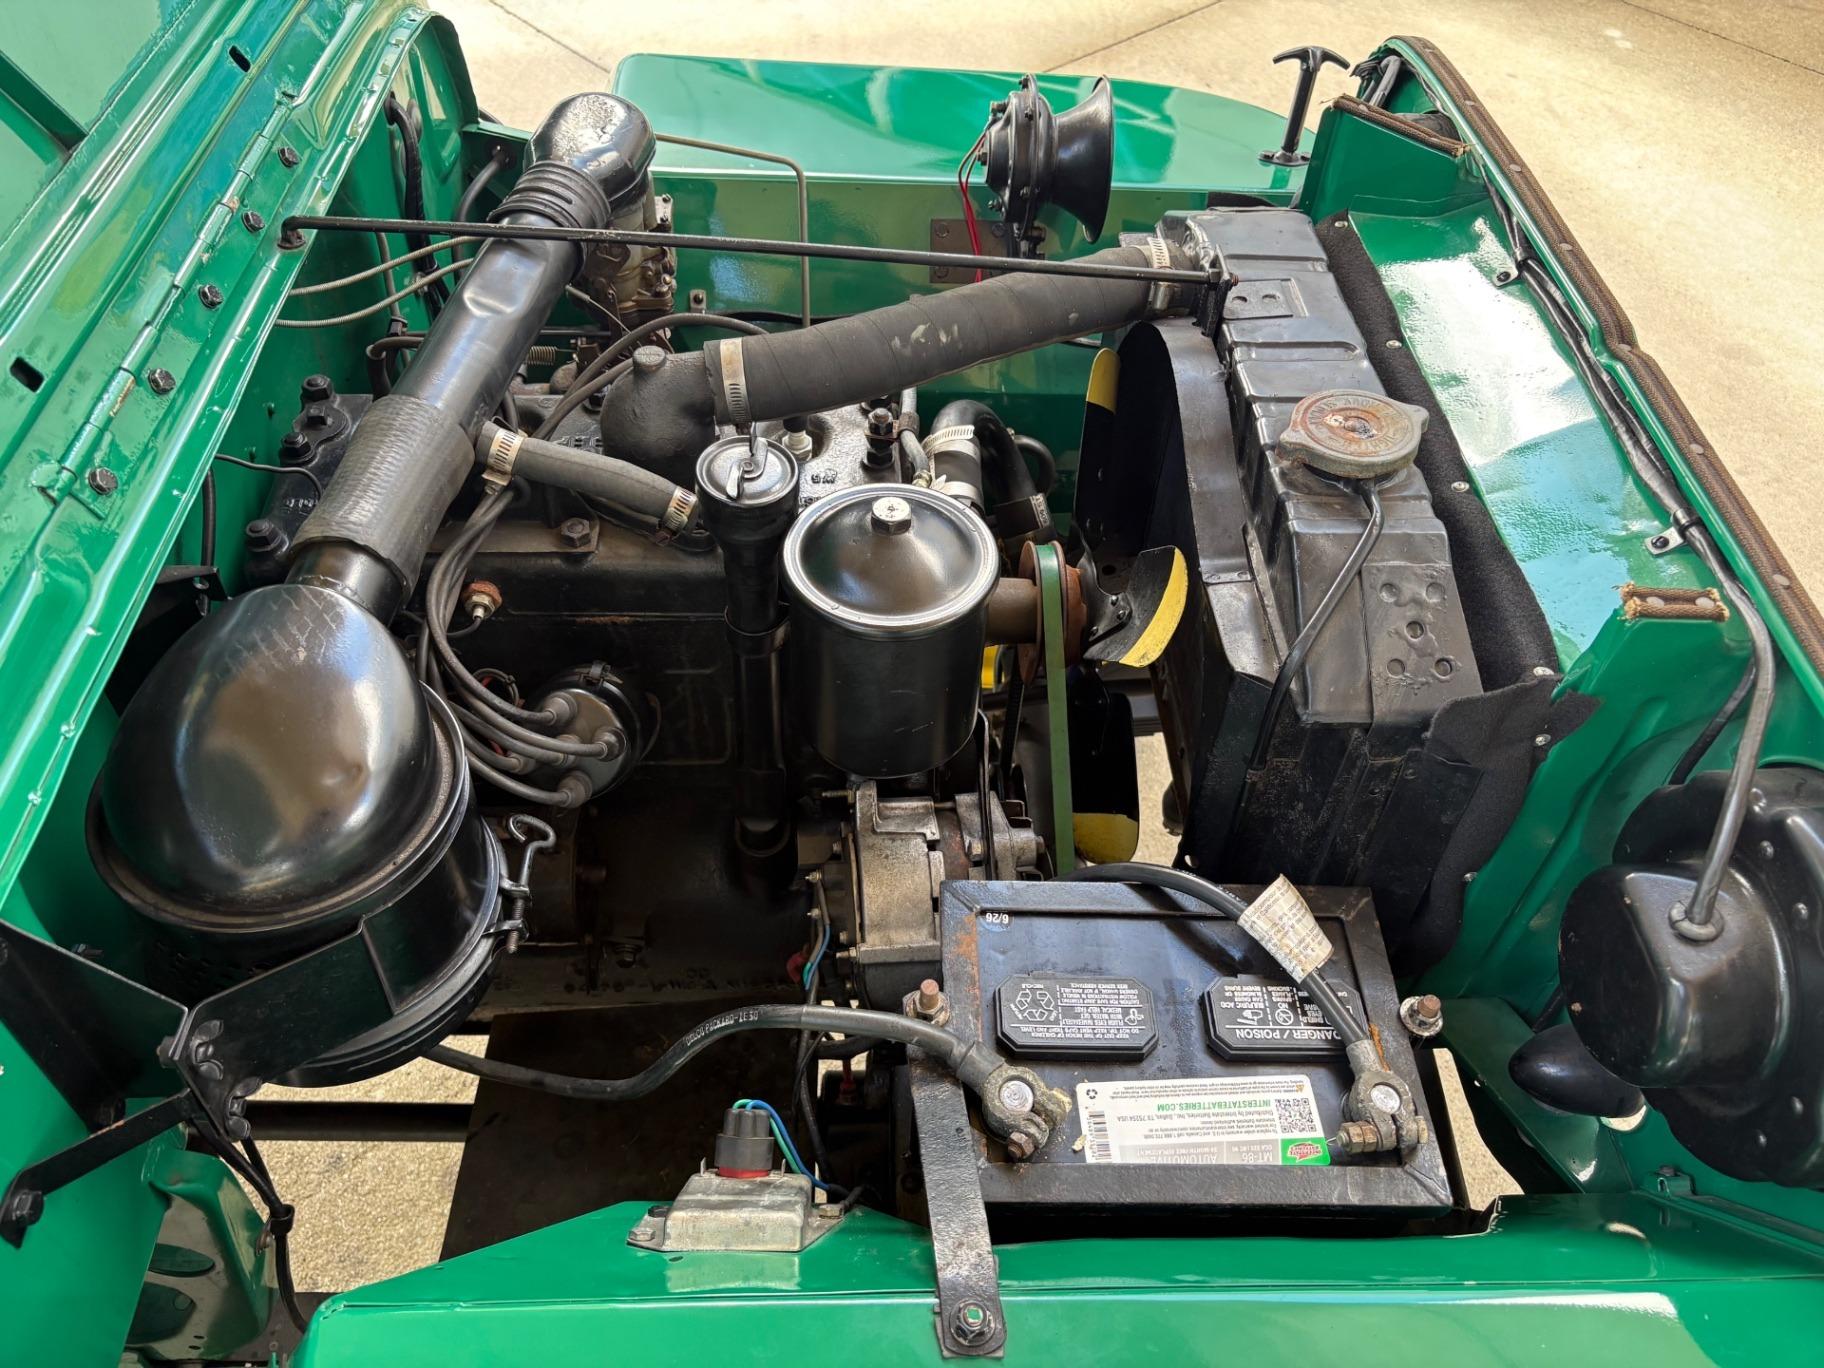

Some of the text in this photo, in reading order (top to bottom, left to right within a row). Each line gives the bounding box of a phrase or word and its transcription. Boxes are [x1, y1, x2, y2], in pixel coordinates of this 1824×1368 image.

[986, 912, 1009, 924] 6/26
[1235, 1029, 1341, 1040] DANGER / POISON
[1157, 1100, 1271, 1112] INTERSTATEBATTERIES.COM
[1151, 1154, 1217, 1164] AUTOMOTIVE
[1242, 1152, 1272, 1163] MT-86
